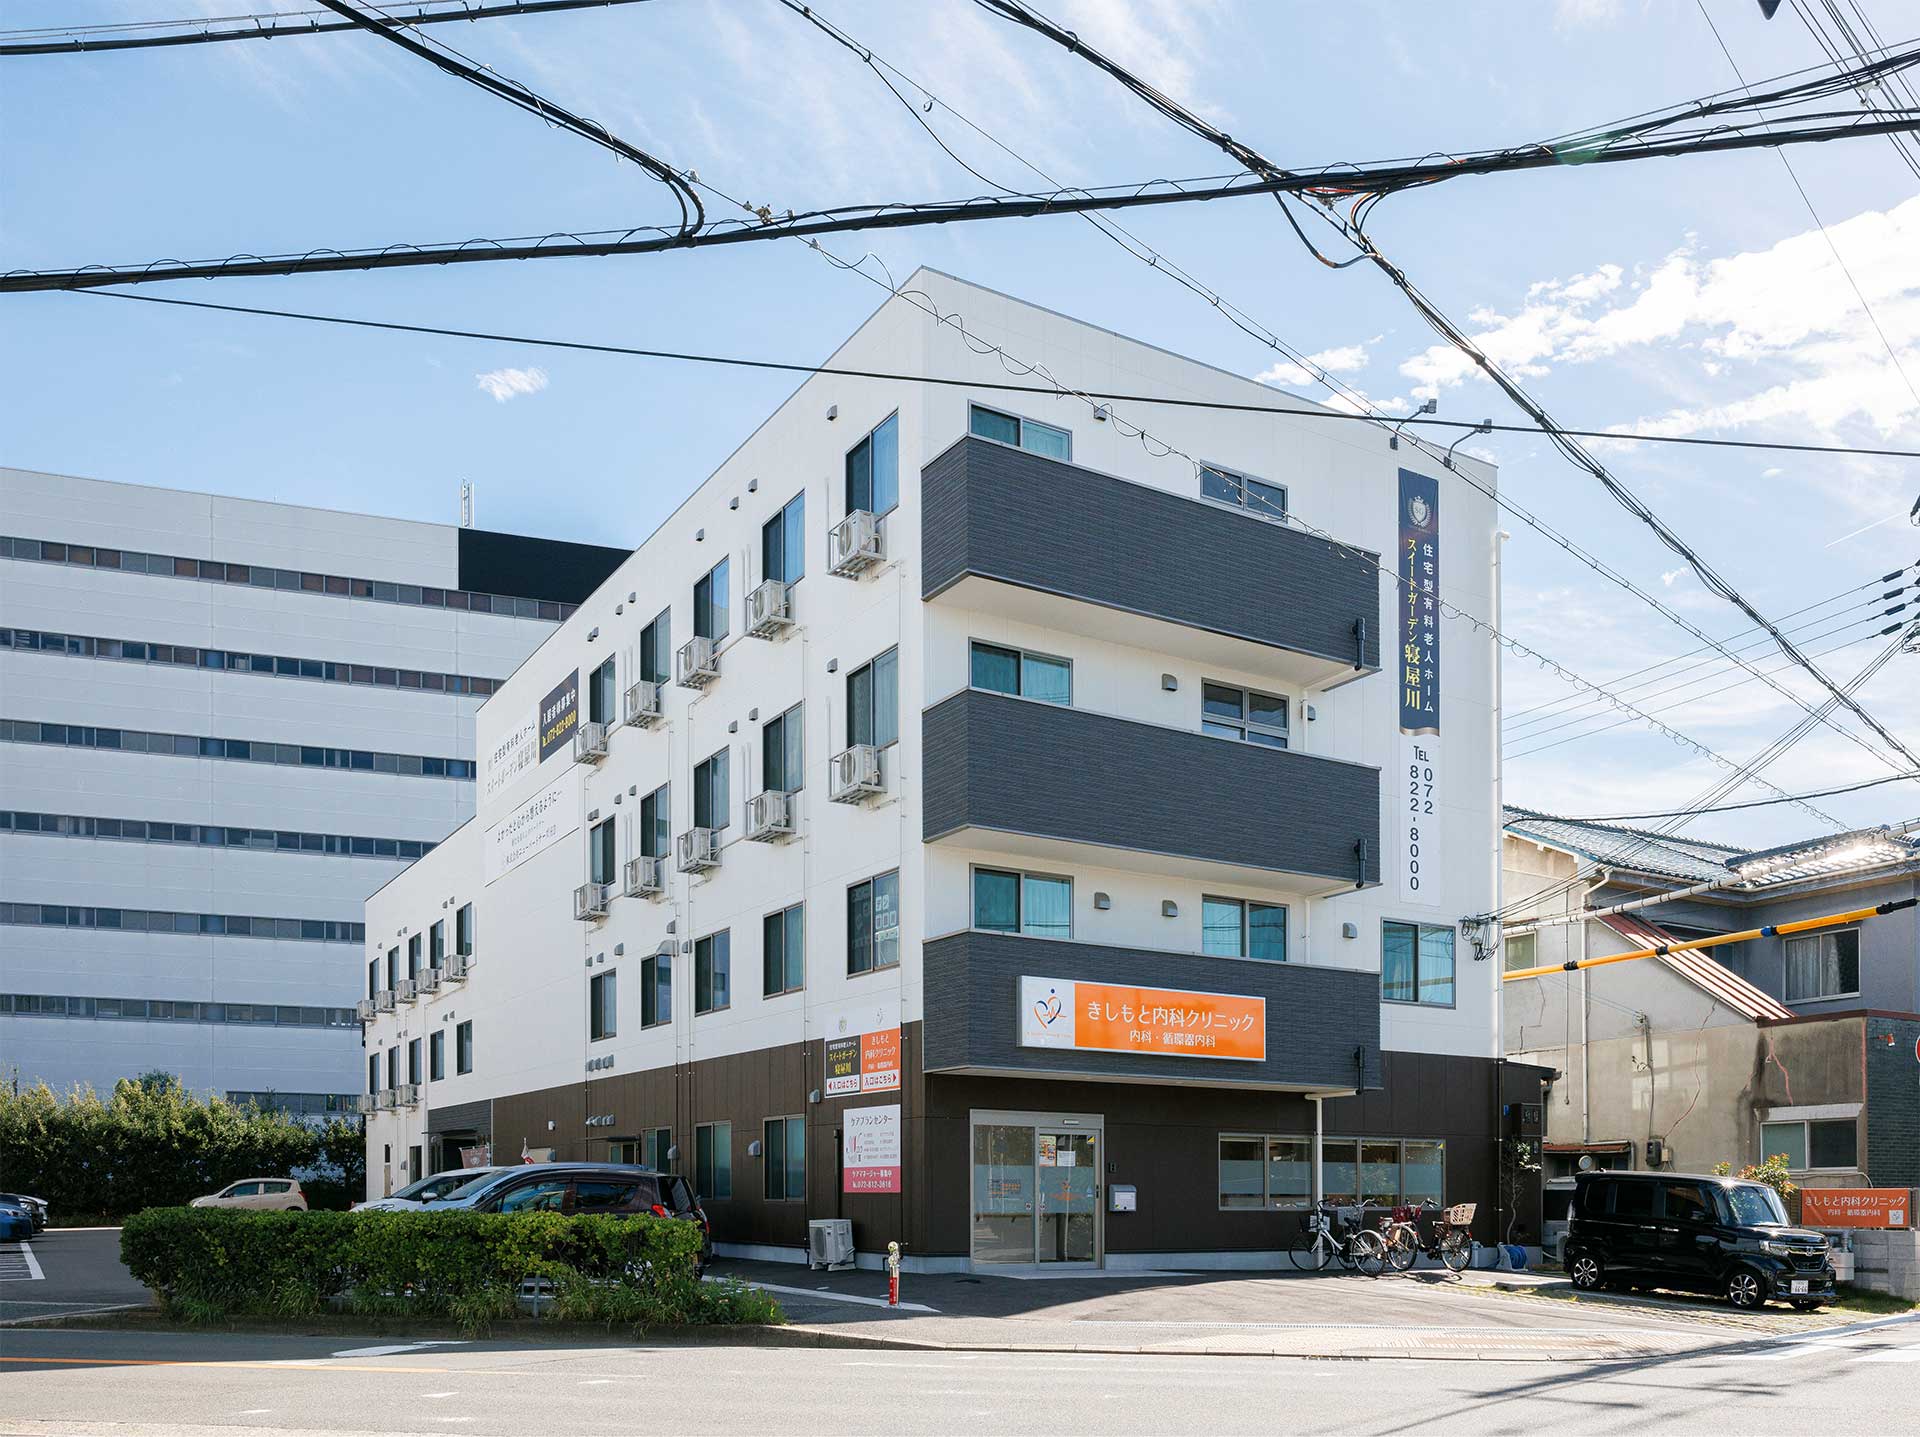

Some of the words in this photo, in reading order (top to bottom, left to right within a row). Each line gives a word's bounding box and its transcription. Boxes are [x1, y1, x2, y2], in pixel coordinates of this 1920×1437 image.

[1404, 538, 1422, 711] スイートガーデン寝屋川
[1422, 543, 1434, 713] 住宅型有料老人ホーム
[1414, 745, 1429, 762] TEL
[1424, 768, 1433, 815] 072
[1410, 765, 1420, 890] 822-8000
[1087, 1001, 1255, 1032] きしもと内科クリニック
[872, 1034, 889, 1046] きしもと
[1129, 1030, 1216, 1048] 内科・循環器内科
[828, 1050, 858, 1061] スイートガーデン
[865, 1046, 896, 1060] 内科クリニック
[834, 1062, 852, 1075] 寝屋川
[832, 1078, 858, 1090] 入口はこちら
[864, 1074, 892, 1086] 入口はこちら
[851, 1114, 893, 1127] ケアプランセンター
[1805, 1196, 1906, 1207] きしもと内科クリニック
